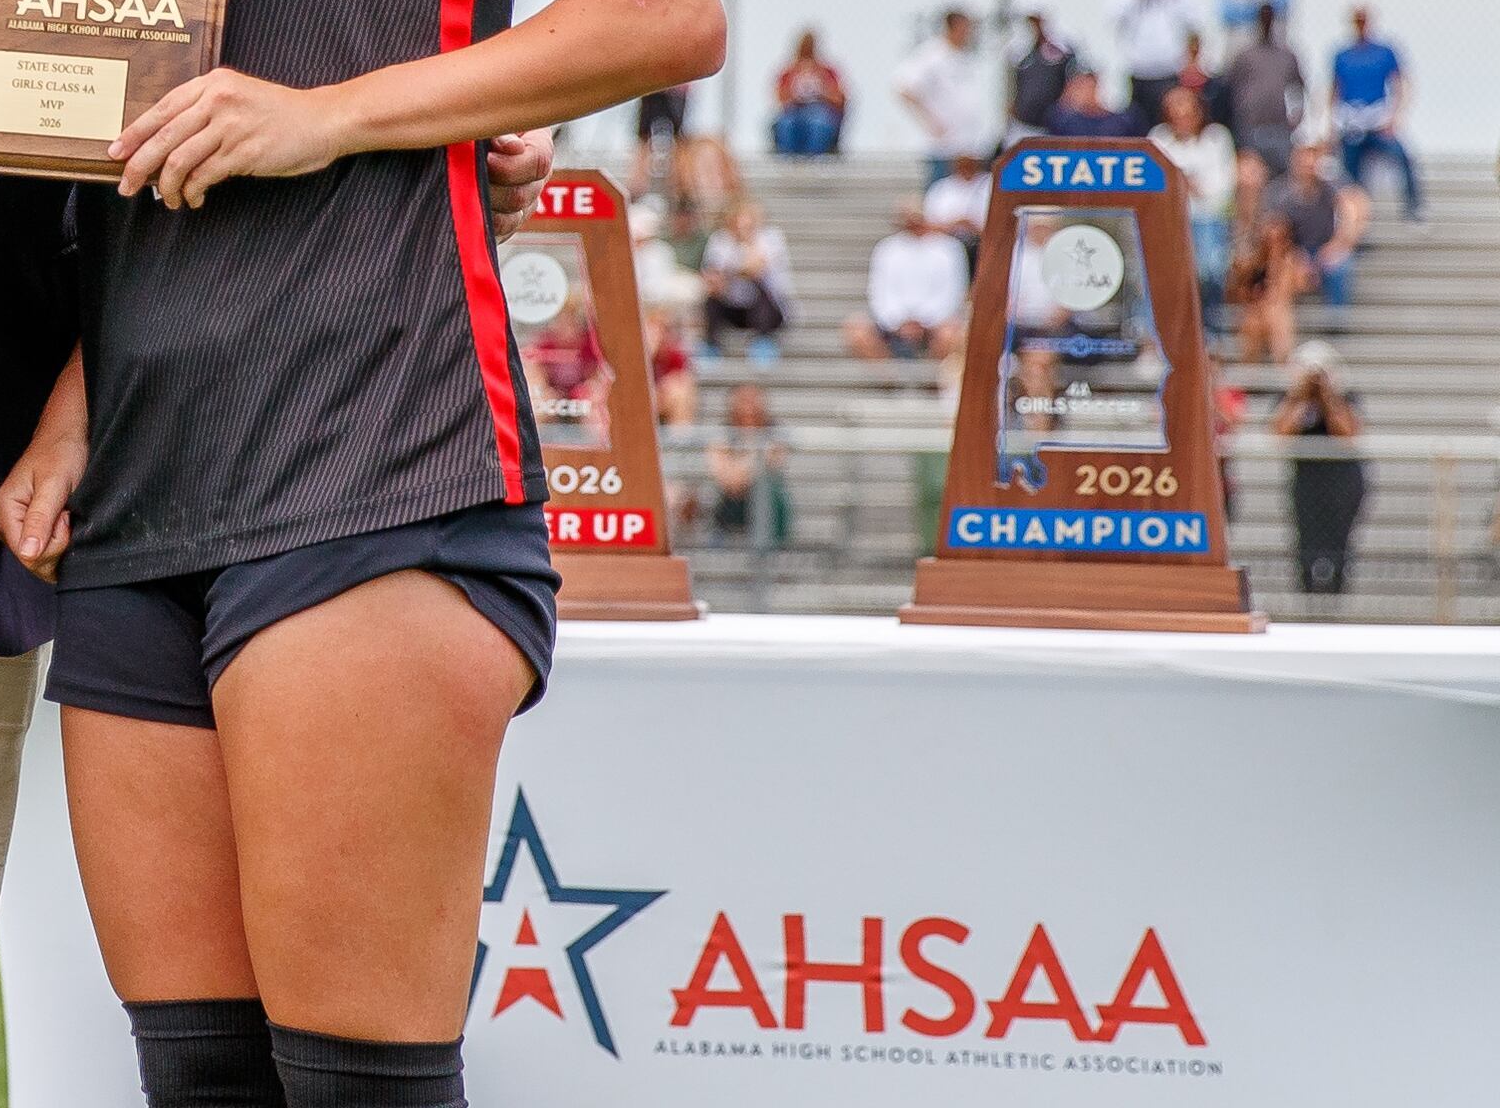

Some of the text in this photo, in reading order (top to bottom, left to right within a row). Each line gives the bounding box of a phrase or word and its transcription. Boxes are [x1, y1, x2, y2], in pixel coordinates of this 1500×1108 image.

[7, 19, 191, 43] ALABAMA HIGH SCHOOL ATHLETIC ASSOCIATION
[16, 60, 94, 76] STATE SOCCER
[12, 78, 95, 95] GIRLS CLASS 4A
[40, 99, 65, 110] MVP
[39, 117, 61, 129] 2026
[1022, 155, 1147, 187] STATE
[1015, 396, 1068, 415] GIRLS
[544, 465, 623, 495] 026
[1075, 465, 1179, 497] 2026
[593, 512, 646, 542] UP
[956, 513, 1202, 548] CHAMPION
[668, 910, 1208, 1047] AHSAA
[653, 1040, 1224, 1077] ALABAMA HIGH SCHOOL ATHLETIC ASSOCIATION
